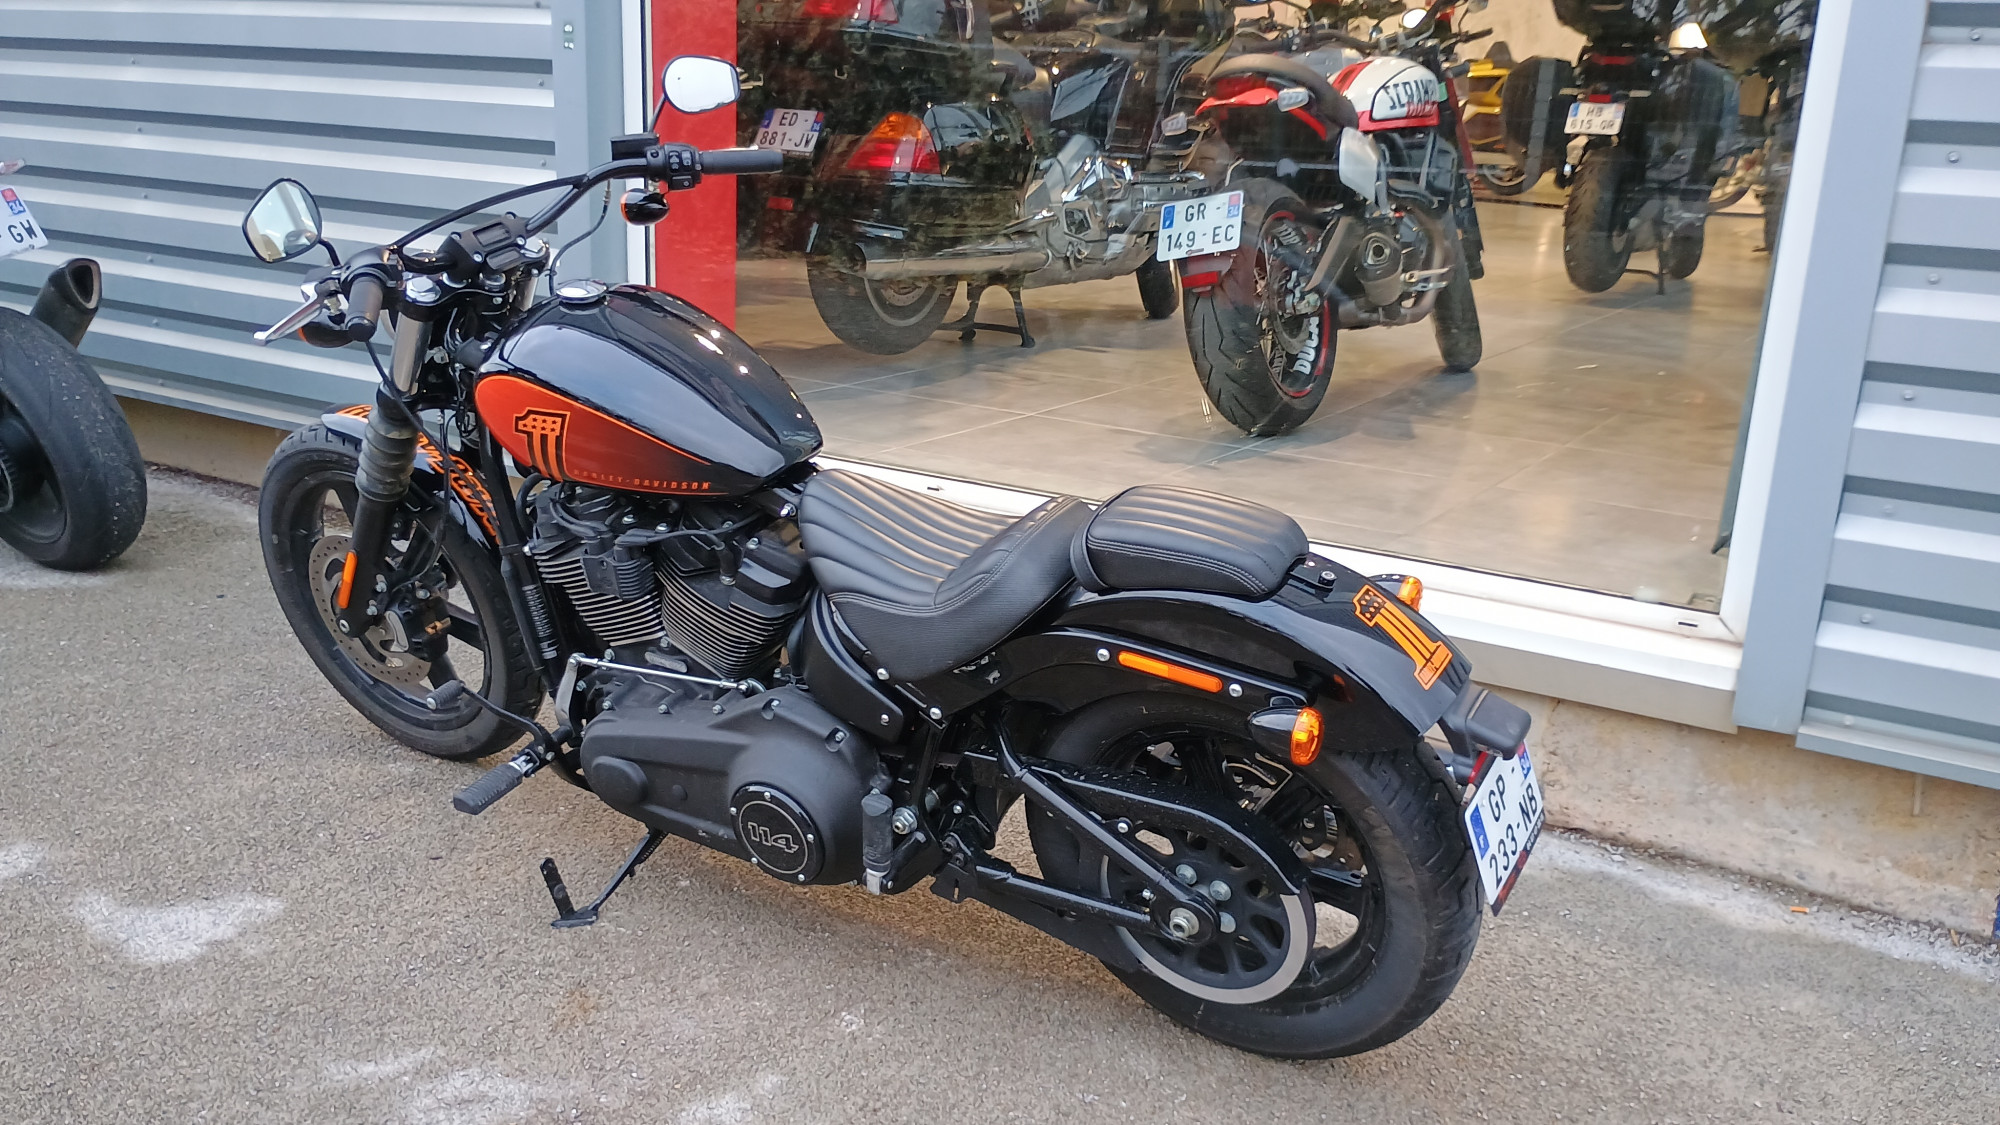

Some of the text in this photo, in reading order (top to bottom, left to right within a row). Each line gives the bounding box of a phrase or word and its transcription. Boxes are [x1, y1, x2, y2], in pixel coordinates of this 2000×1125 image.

[779, 112, 799, 126] ED
[760, 131, 814, 149] 881-JV
[1185, 202, 1207, 222] GR
[1228, 206, 1239, 217] 34
[1167, 224, 1234, 252] 149-EC
[1488, 774, 1506, 823] GP
[747, 821, 799, 854] 114
[1489, 782, 1538, 890] 233-NB
